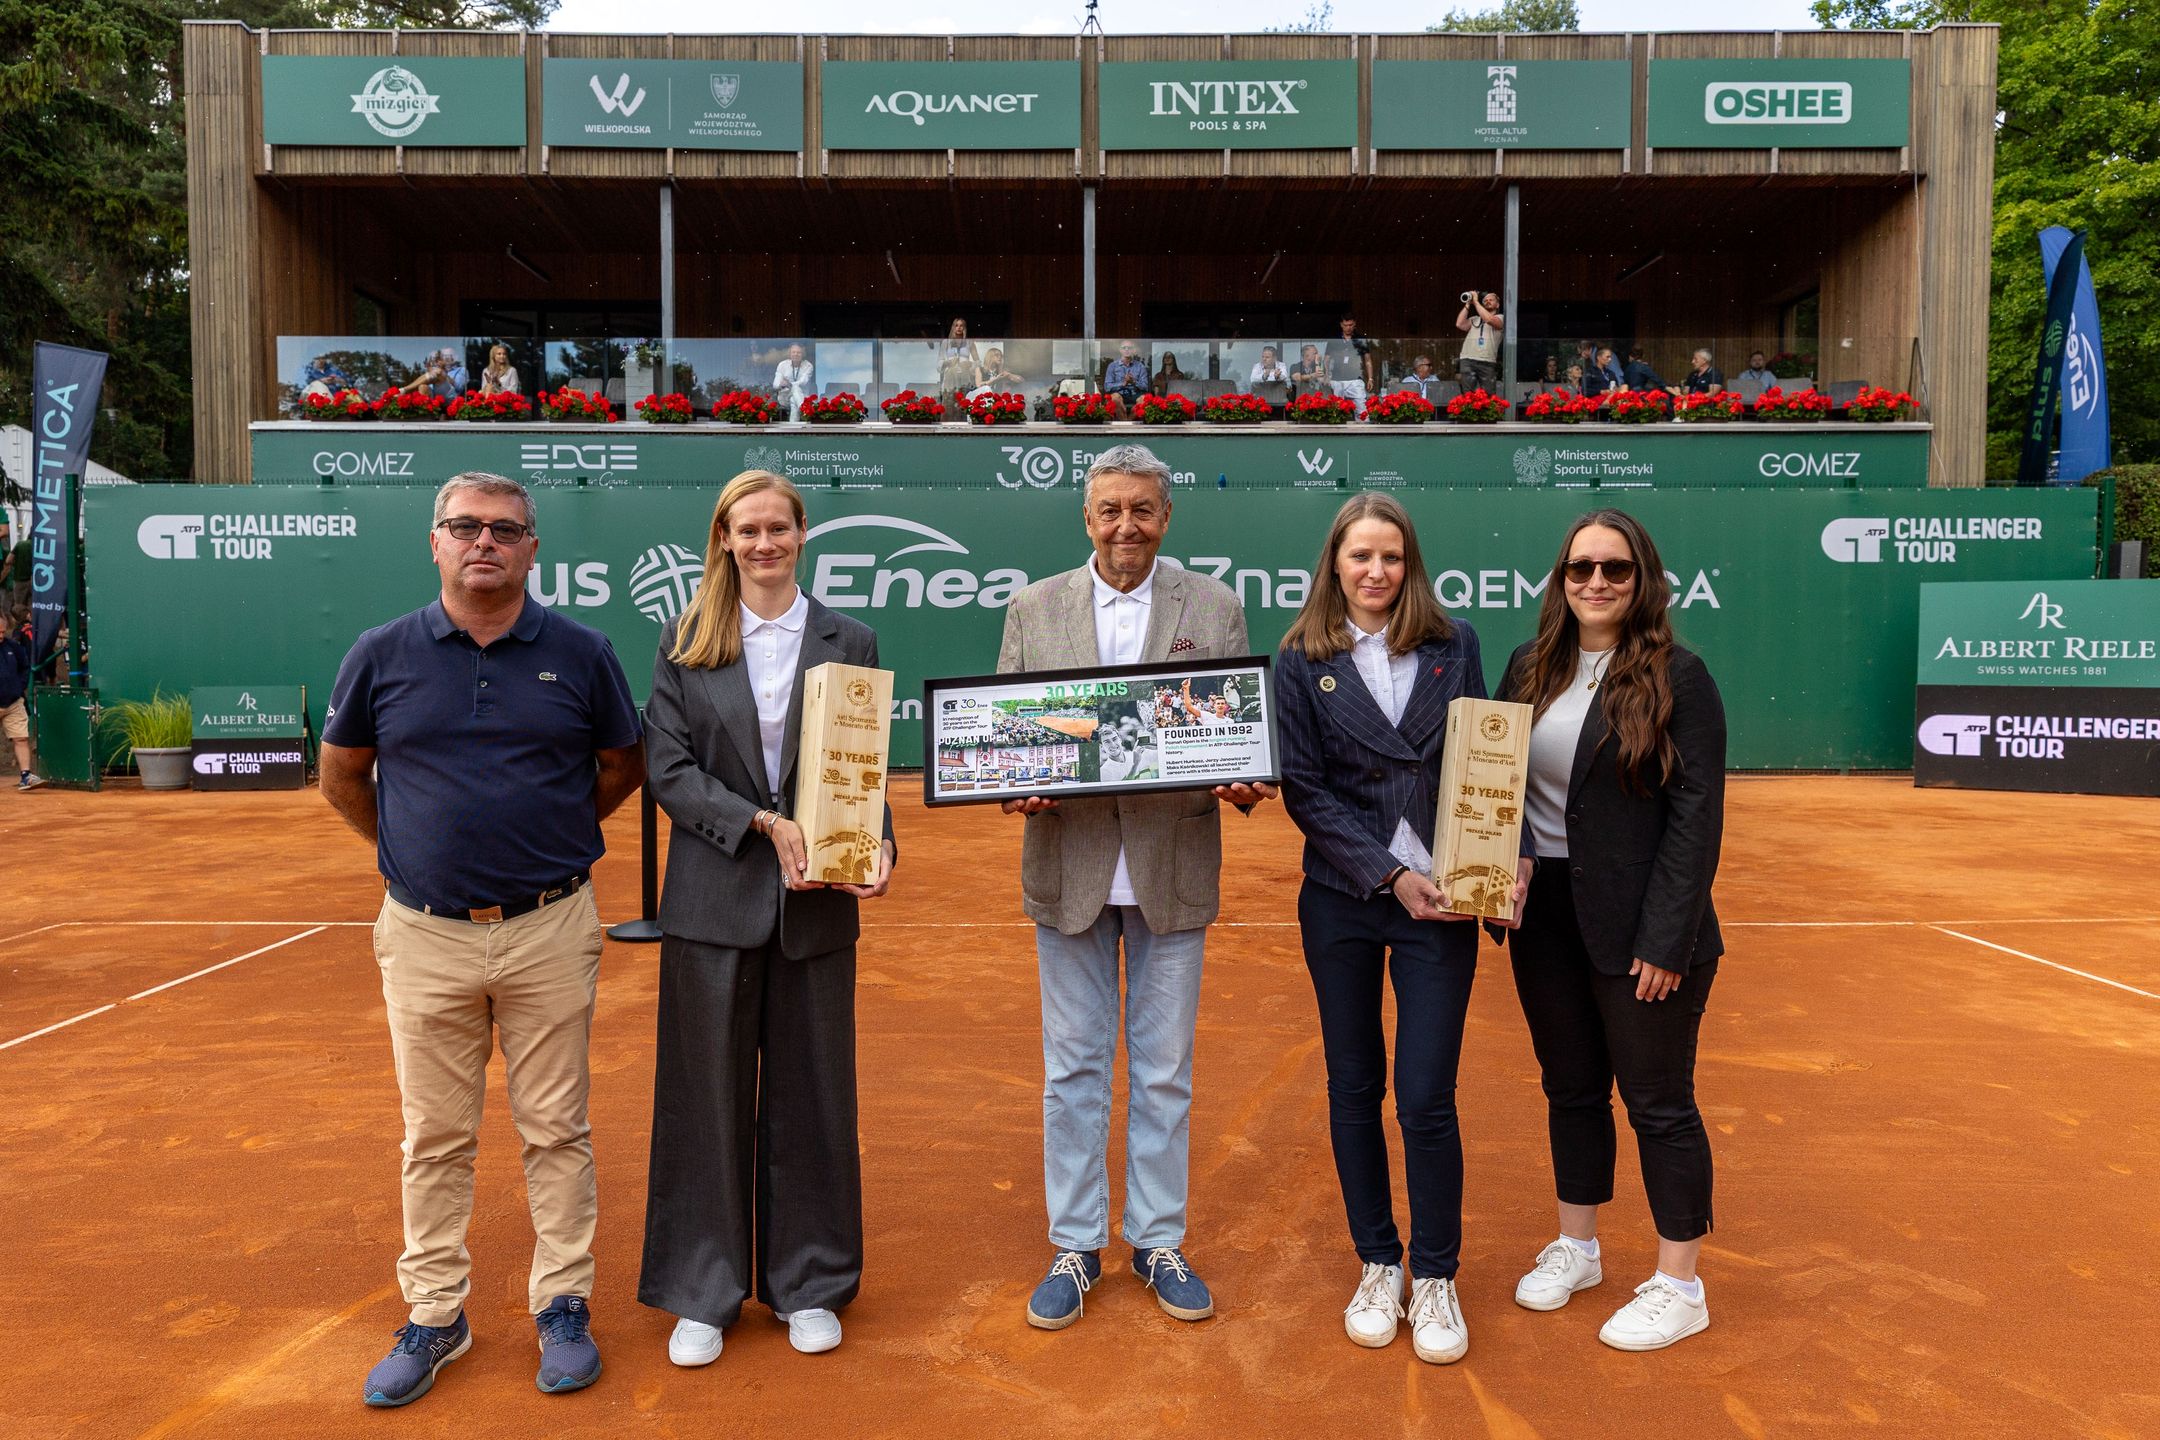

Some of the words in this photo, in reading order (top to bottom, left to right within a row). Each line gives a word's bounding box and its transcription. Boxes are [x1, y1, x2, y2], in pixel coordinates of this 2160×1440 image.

[366, 96, 426, 112] mizgier
[1713, 88, 1843, 117] OSHEE
[703, 112, 747, 121] SAMORZĄD
[584, 124, 651, 134] WIELKOPOLSKA
[694, 119, 757, 128] WOJEWÓDZTWA
[1189, 121, 1228, 130] POOLS
[1232, 121, 1241, 130] &
[1245, 121, 1267, 130] SPA
[688, 128, 762, 137] WIELKOPOLSKIEGO
[1474, 127, 1501, 135] HOTEL
[1502, 127, 1528, 135] ALTUS
[2031, 367, 2053, 441] plus
[521, 444, 637, 470] EDGE
[785, 450, 860, 461] Ministerstwo
[1554, 449, 1629, 461] Ministerstwo
[313, 452, 414, 475] GOMEZ
[1554, 463, 1592, 476] Sportu
[1595, 463, 1599, 474] i
[1601, 463, 1653, 476] Turystyki
[1759, 452, 1861, 476] GOMEZ
[785, 464, 823, 477] Sportu
[826, 464, 830, 475] i
[831, 464, 884, 477] Turystyki
[181, 525, 202, 533] ATP
[210, 514, 357, 537] CHALLENGER
[1894, 517, 2042, 540] CHALLENGER
[1865, 529, 1886, 537] ATP
[210, 537, 272, 560] TOUR
[1894, 541, 1956, 563] TOUR
[811, 553, 1029, 608] Enea
[1934, 636, 2056, 661] ALBERT
[2063, 637, 2156, 661] RIELE
[1977, 665, 2015, 675] SWISS
[2018, 665, 2078, 676] WATCHES
[2082, 666, 2107, 676] 1881
[1045, 685, 1065, 699] 30
[1070, 681, 1128, 697] YEARS
[200, 713, 254, 726] ALBERT
[257, 713, 297, 725] RIELE
[839, 721, 863, 729] Moscato
[1164, 727, 1212, 739] FOUNDED
[1215, 726, 1225, 736] IN
[1227, 725, 1253, 735] 1992
[1995, 716, 2160, 740] CHALLENGER
[982, 733, 1009, 743] OPEN
[1482, 750, 1514, 759] Spumante
[1996, 737, 2065, 760] TOUR
[228, 752, 302, 763] CHALLENGER
[829, 751, 841, 761] 30
[845, 753, 879, 765] YEARS
[1473, 756, 1498, 764] Moscato
[229, 763, 261, 774] TOUR
[1461, 785, 1475, 796] 30
[1479, 787, 1515, 800] YEARS
